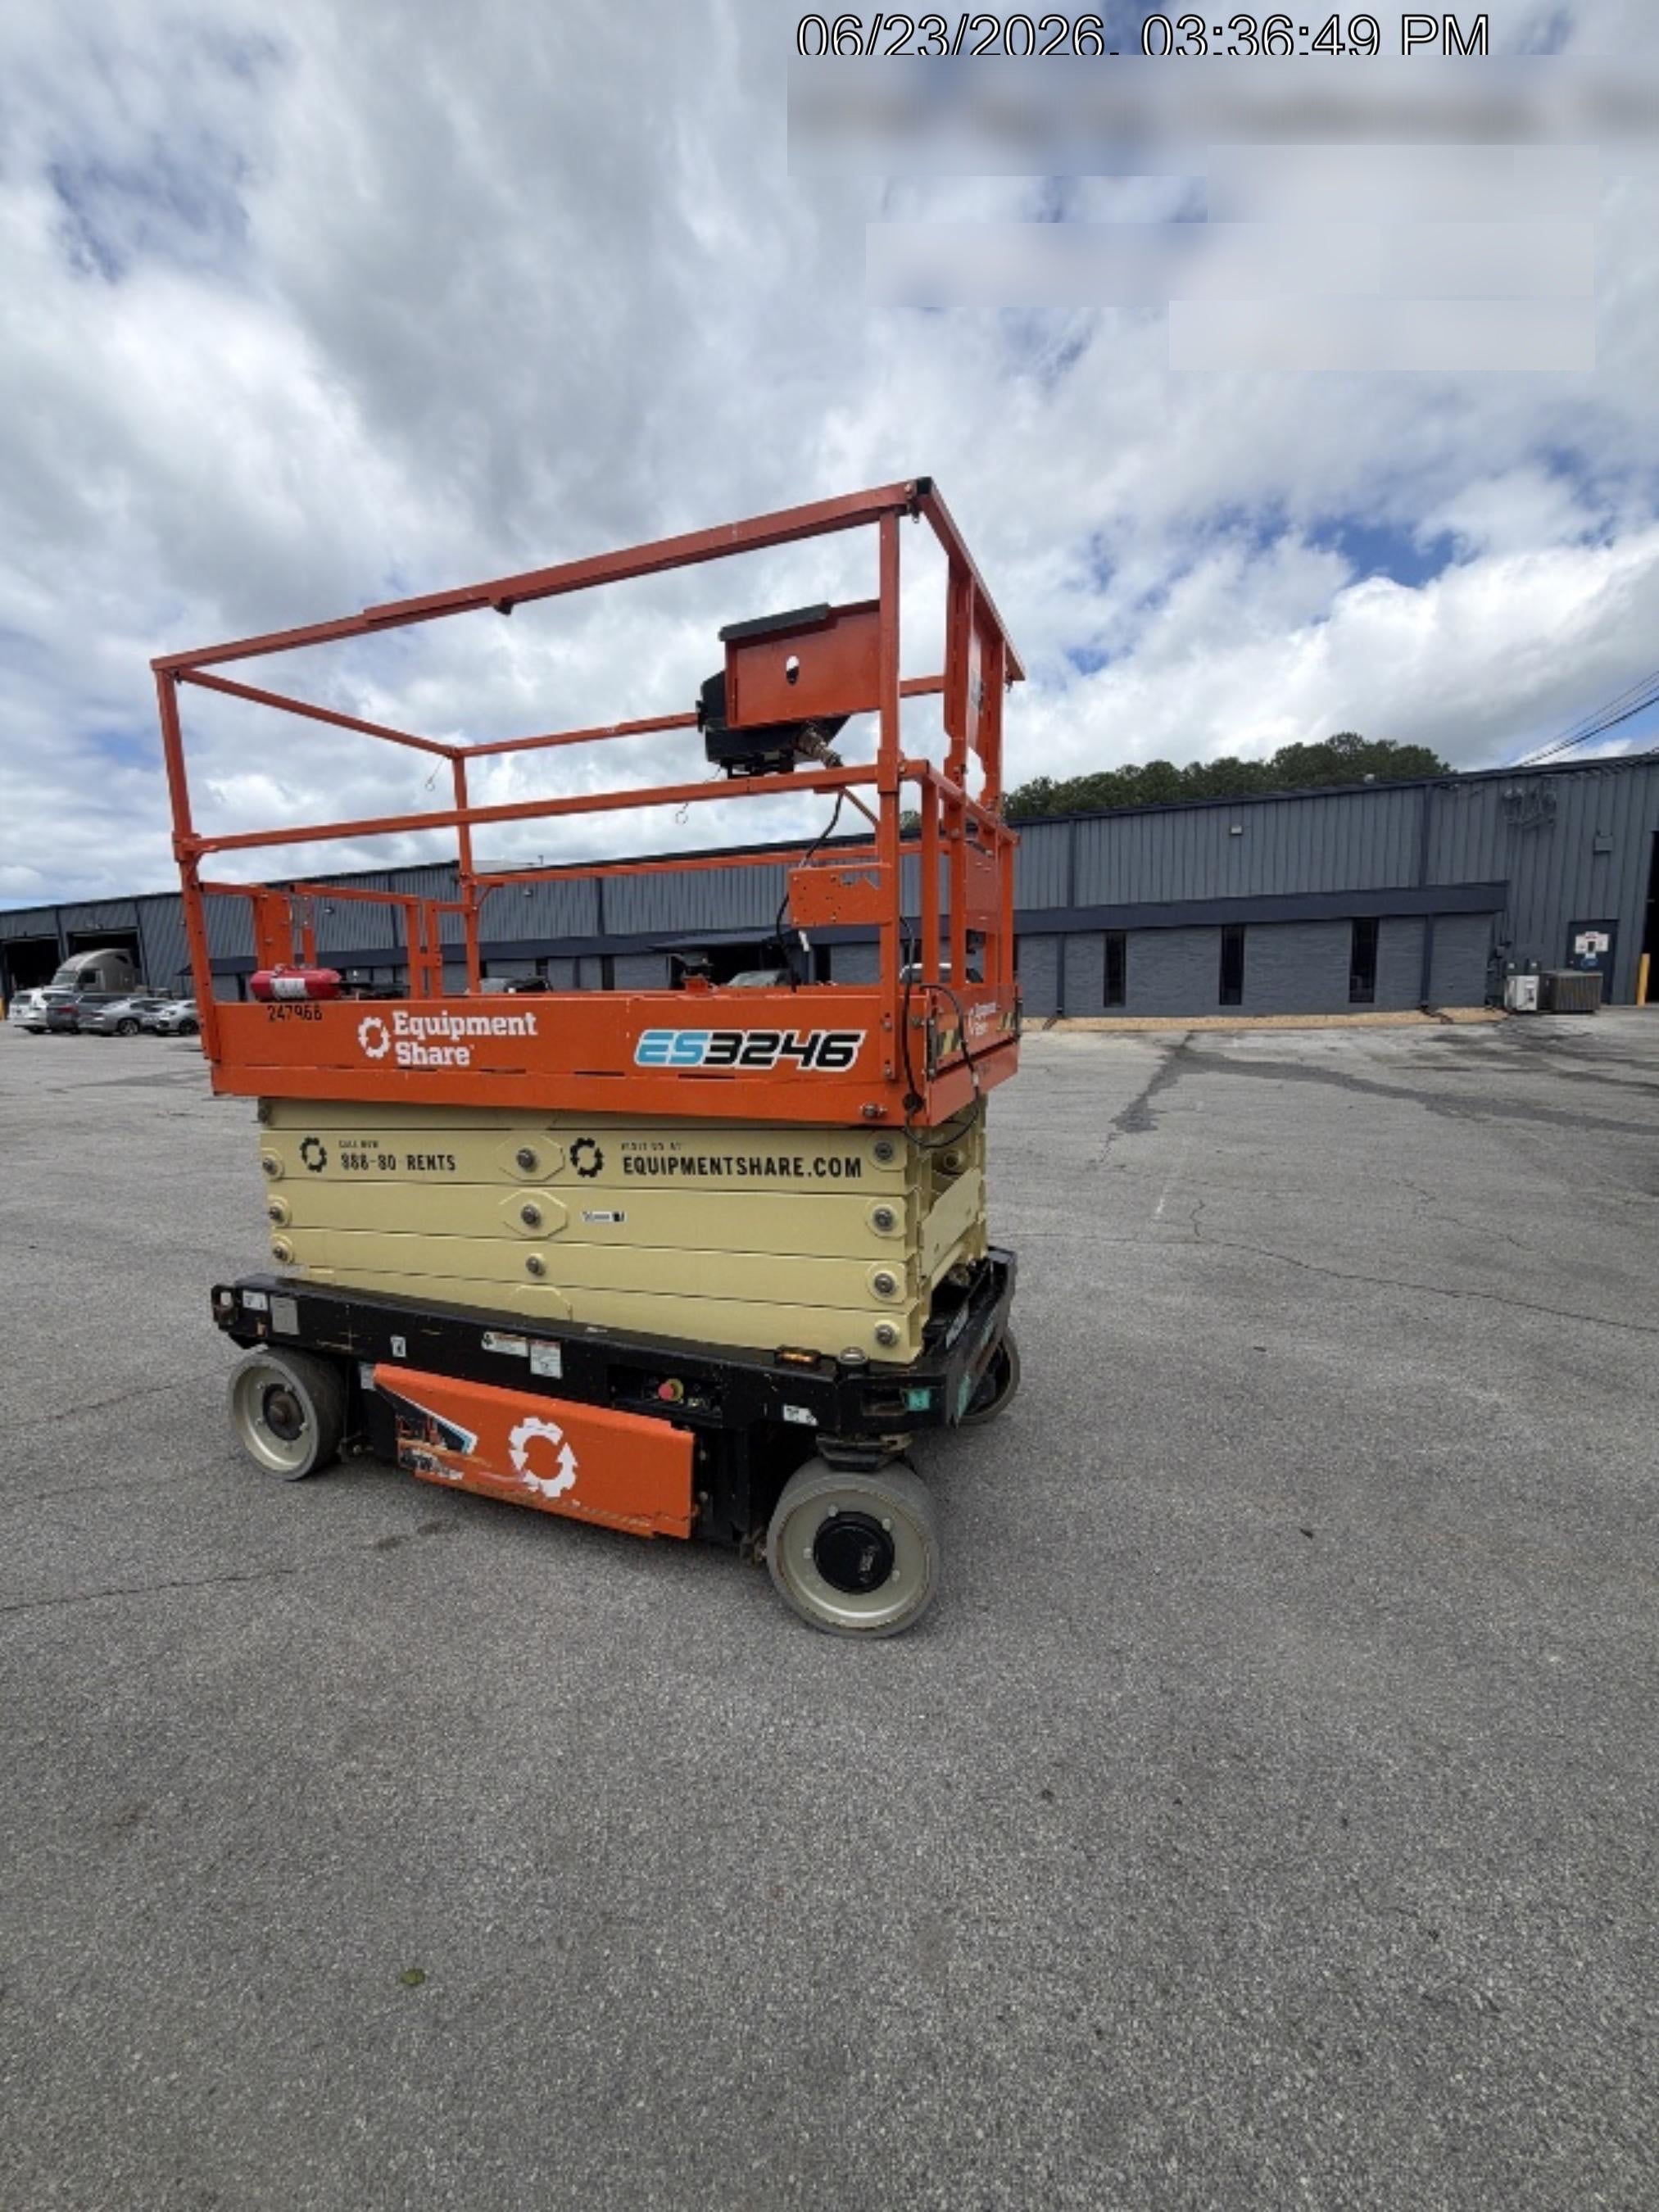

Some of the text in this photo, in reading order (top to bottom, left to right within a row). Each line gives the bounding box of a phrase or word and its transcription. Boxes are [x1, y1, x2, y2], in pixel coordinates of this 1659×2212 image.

[392, 1010, 538, 1041] Equipment
[395, 1041, 470, 1065] Share
[634, 1029, 867, 1072] ES3246
[406, 1154, 456, 1171] RENTS
[623, 1156, 862, 1179] EQUIPMENTSHARE.COM
